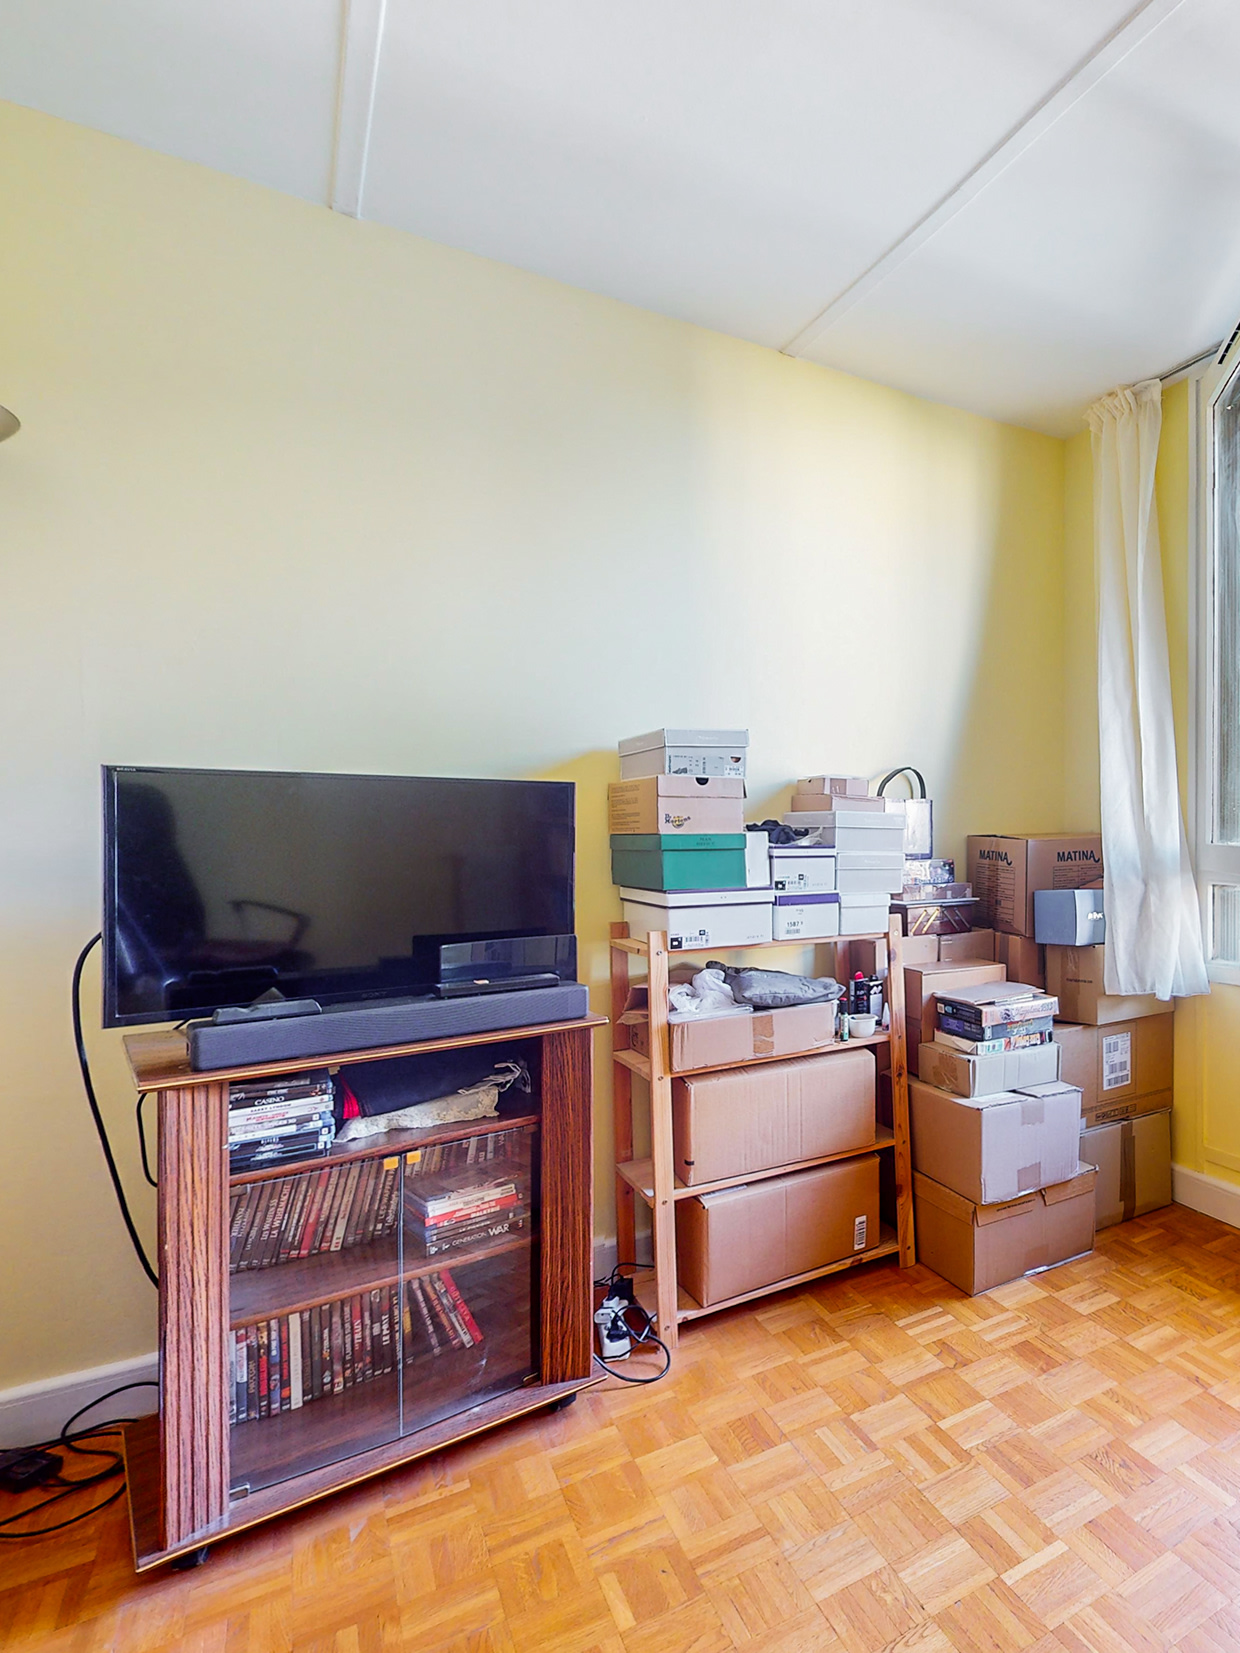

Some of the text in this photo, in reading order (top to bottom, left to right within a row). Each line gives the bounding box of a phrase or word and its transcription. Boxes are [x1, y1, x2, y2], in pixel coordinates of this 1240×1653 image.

[979, 849, 1012, 866] MATINA
[1056, 850, 1100, 863] MATINA
[254, 1095, 284, 1105] CASINO
[262, 1205, 275, 1231] WAFFEN
[269, 1182, 290, 1239] LA WEHRMACHT
[451, 1223, 510, 1246] GENERATION WAR
[353, 1318, 362, 1342] TRAIN
